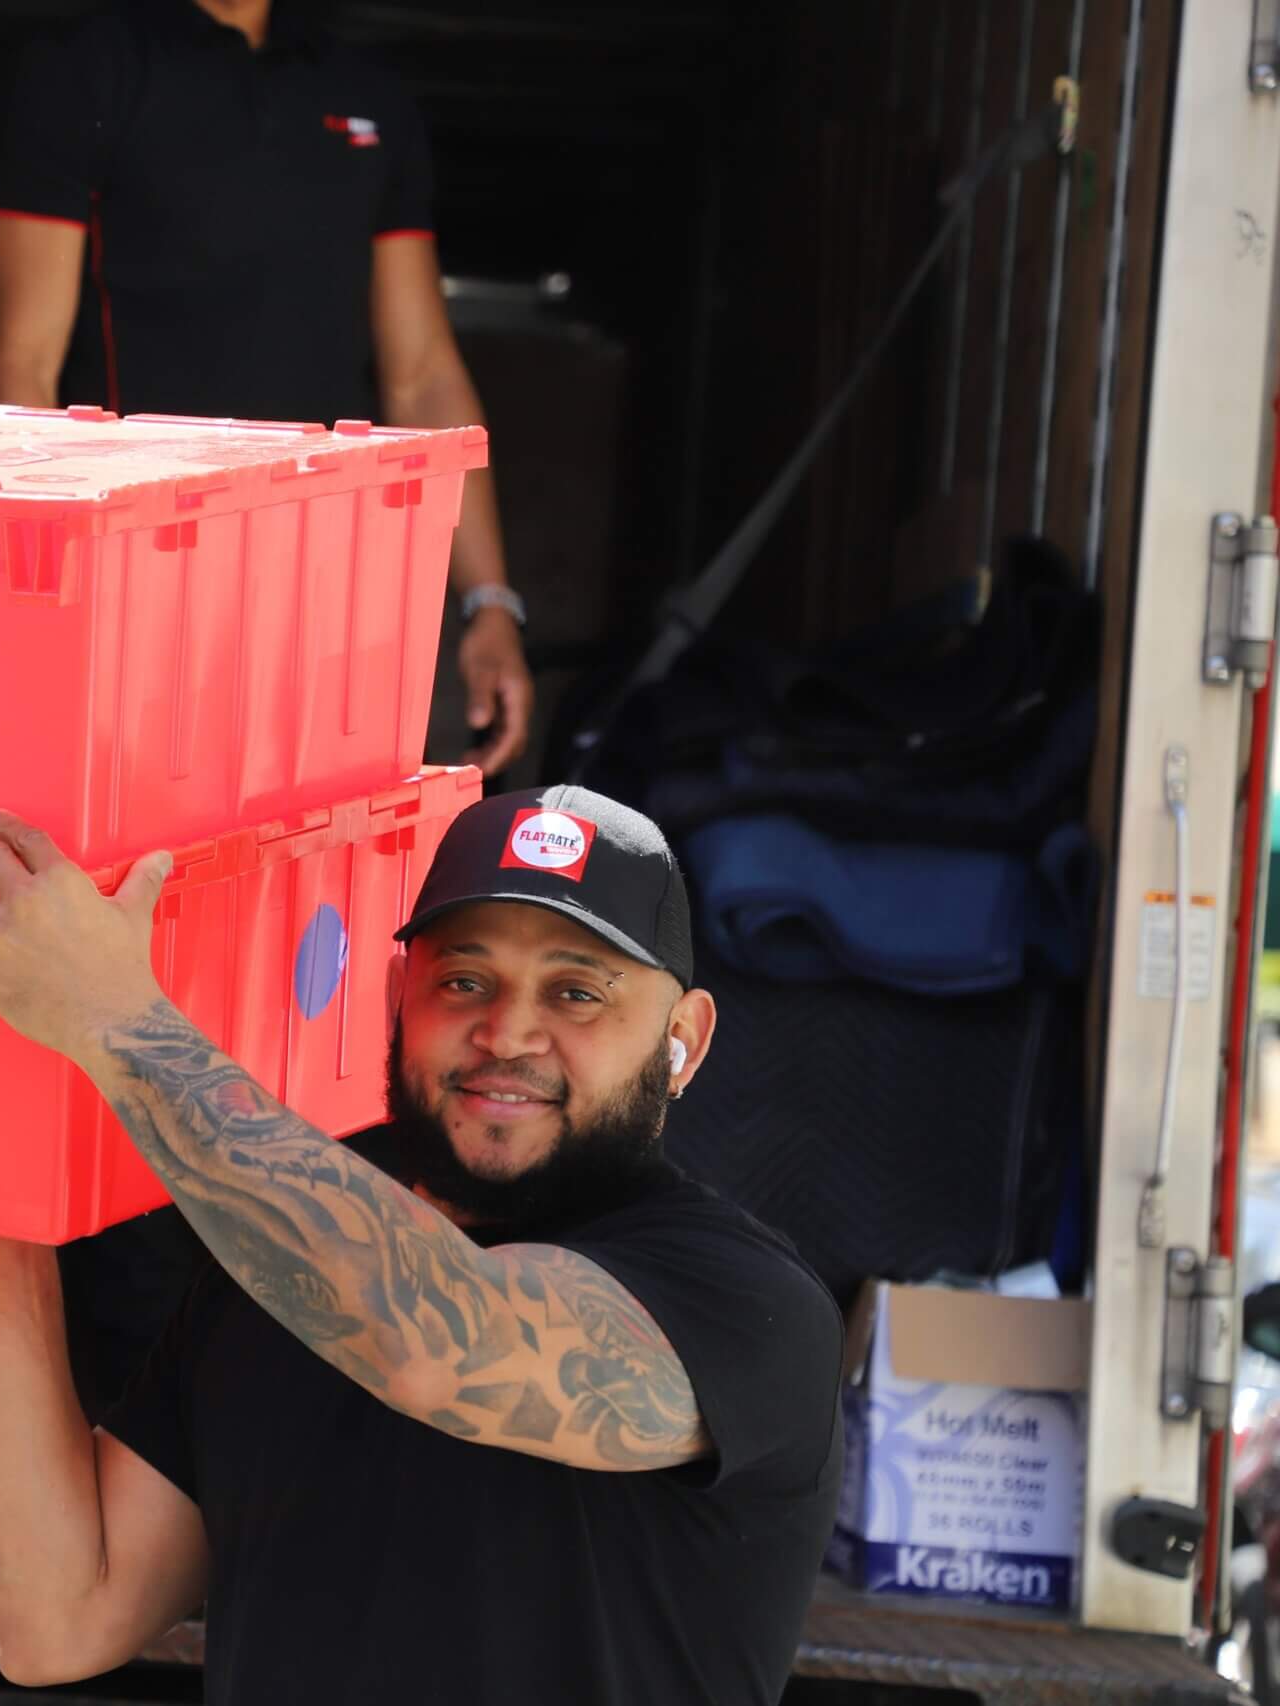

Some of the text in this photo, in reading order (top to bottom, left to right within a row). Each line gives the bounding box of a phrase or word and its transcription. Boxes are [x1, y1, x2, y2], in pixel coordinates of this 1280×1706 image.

[520, 830, 577, 848] FLATRATE
[924, 1409, 1039, 1442] Hot Melt
[956, 1514, 1034, 1537] ROLLS
[896, 1547, 1050, 1597] Kraken
